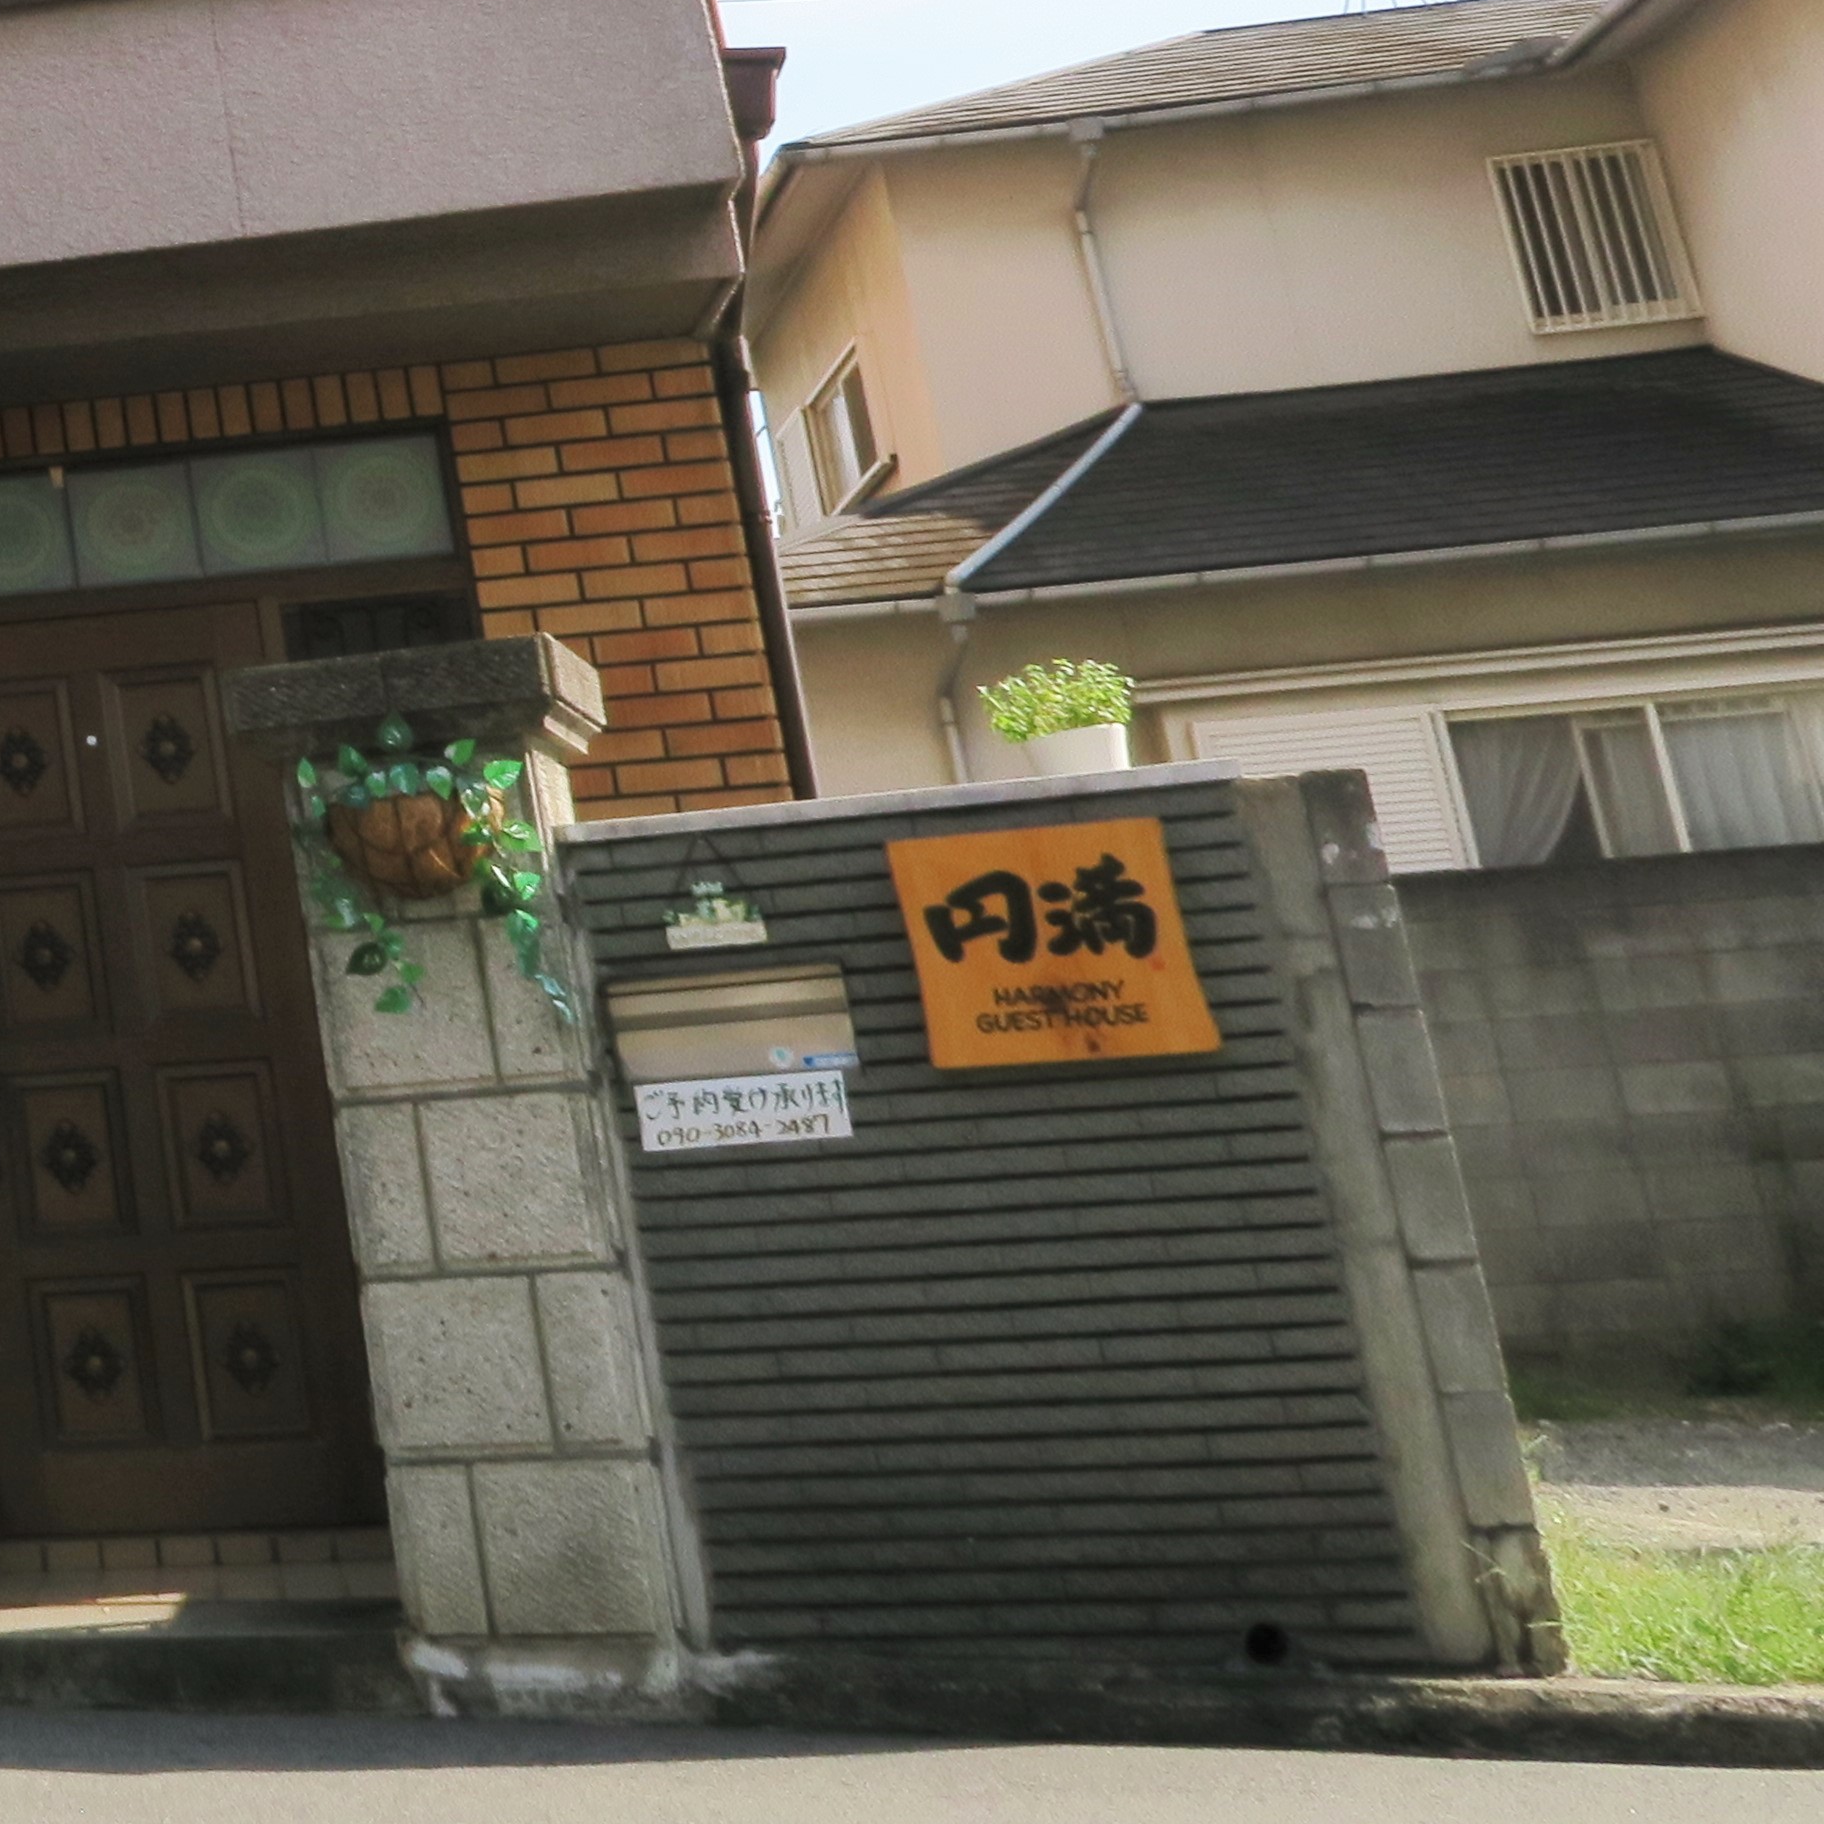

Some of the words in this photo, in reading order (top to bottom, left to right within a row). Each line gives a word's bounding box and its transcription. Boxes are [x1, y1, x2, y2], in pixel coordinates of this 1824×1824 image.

[922, 852, 1159, 964] 円満
[992, 979, 1125, 1007] HARMONY
[974, 1010, 1054, 1034] GUEST
[1065, 1002, 1150, 1028] HOUSE
